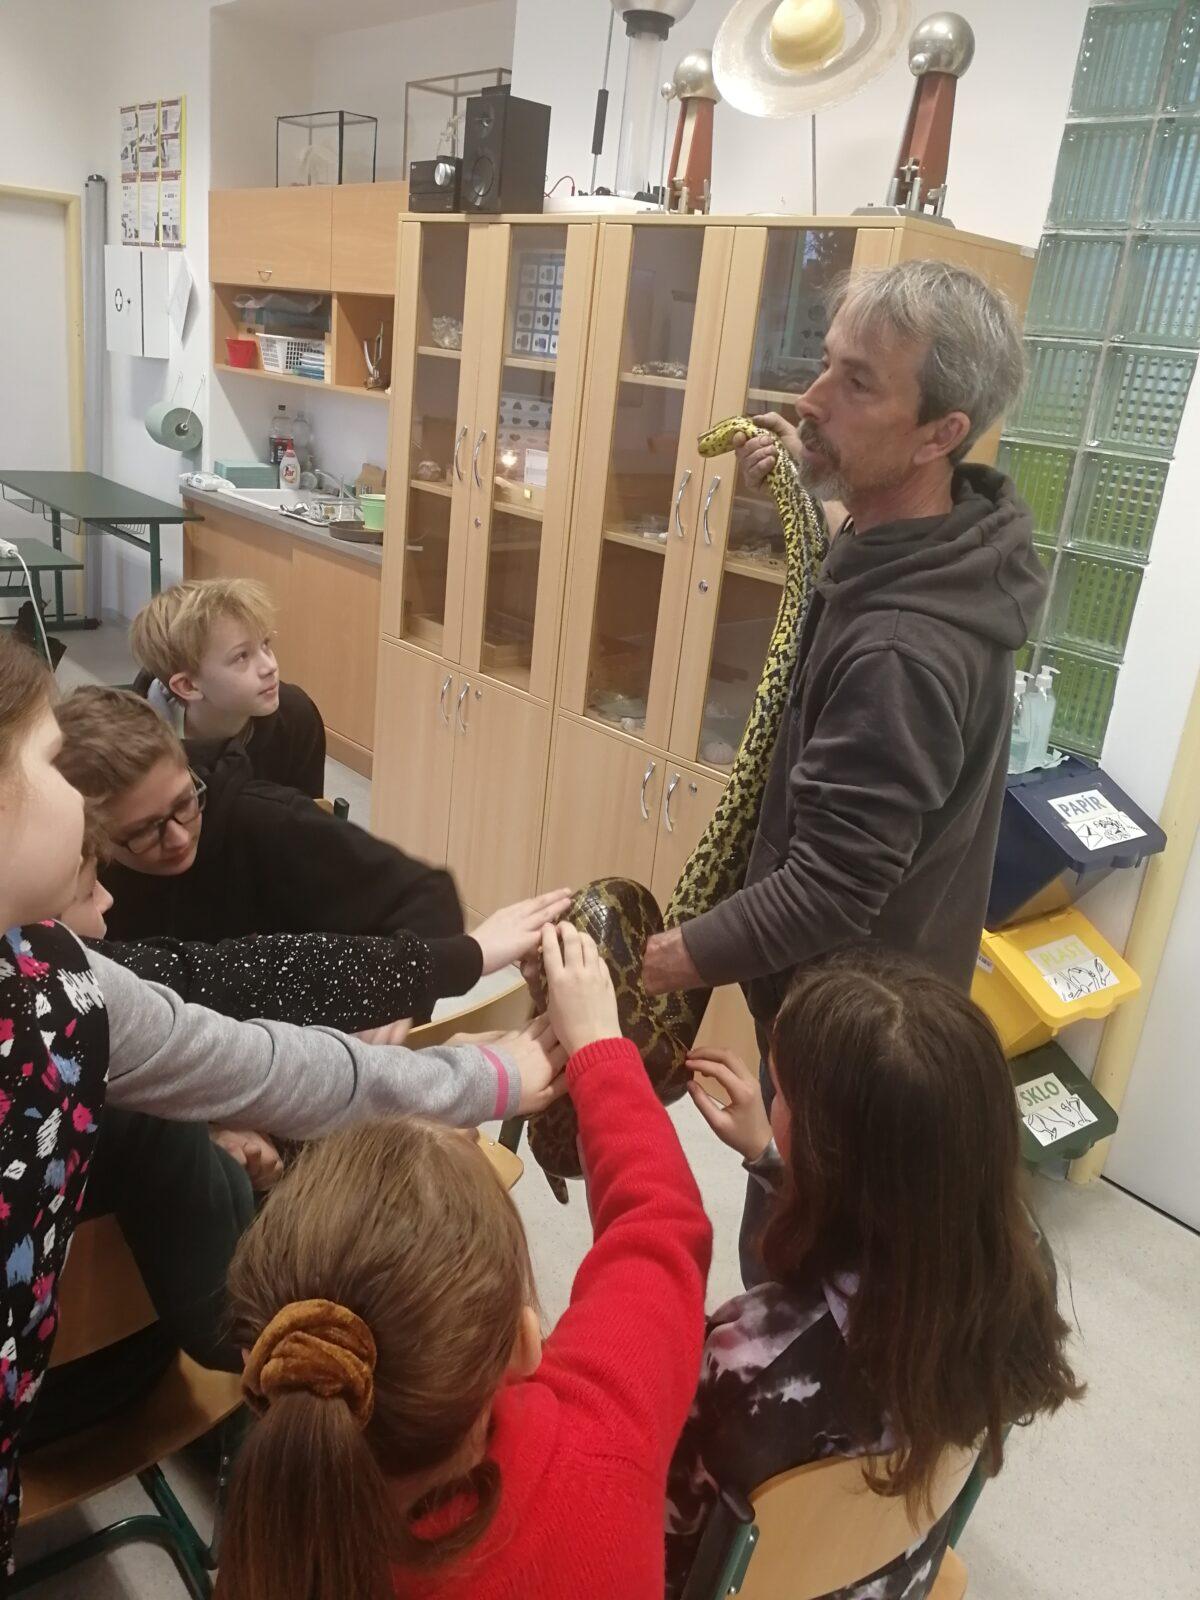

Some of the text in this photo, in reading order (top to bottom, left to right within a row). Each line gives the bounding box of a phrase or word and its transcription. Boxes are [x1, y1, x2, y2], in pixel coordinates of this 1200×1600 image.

[1058, 794, 1107, 817] PAPÍR
[1039, 941, 1085, 967] PLAST
[1020, 1081, 1060, 1107] SKLO
